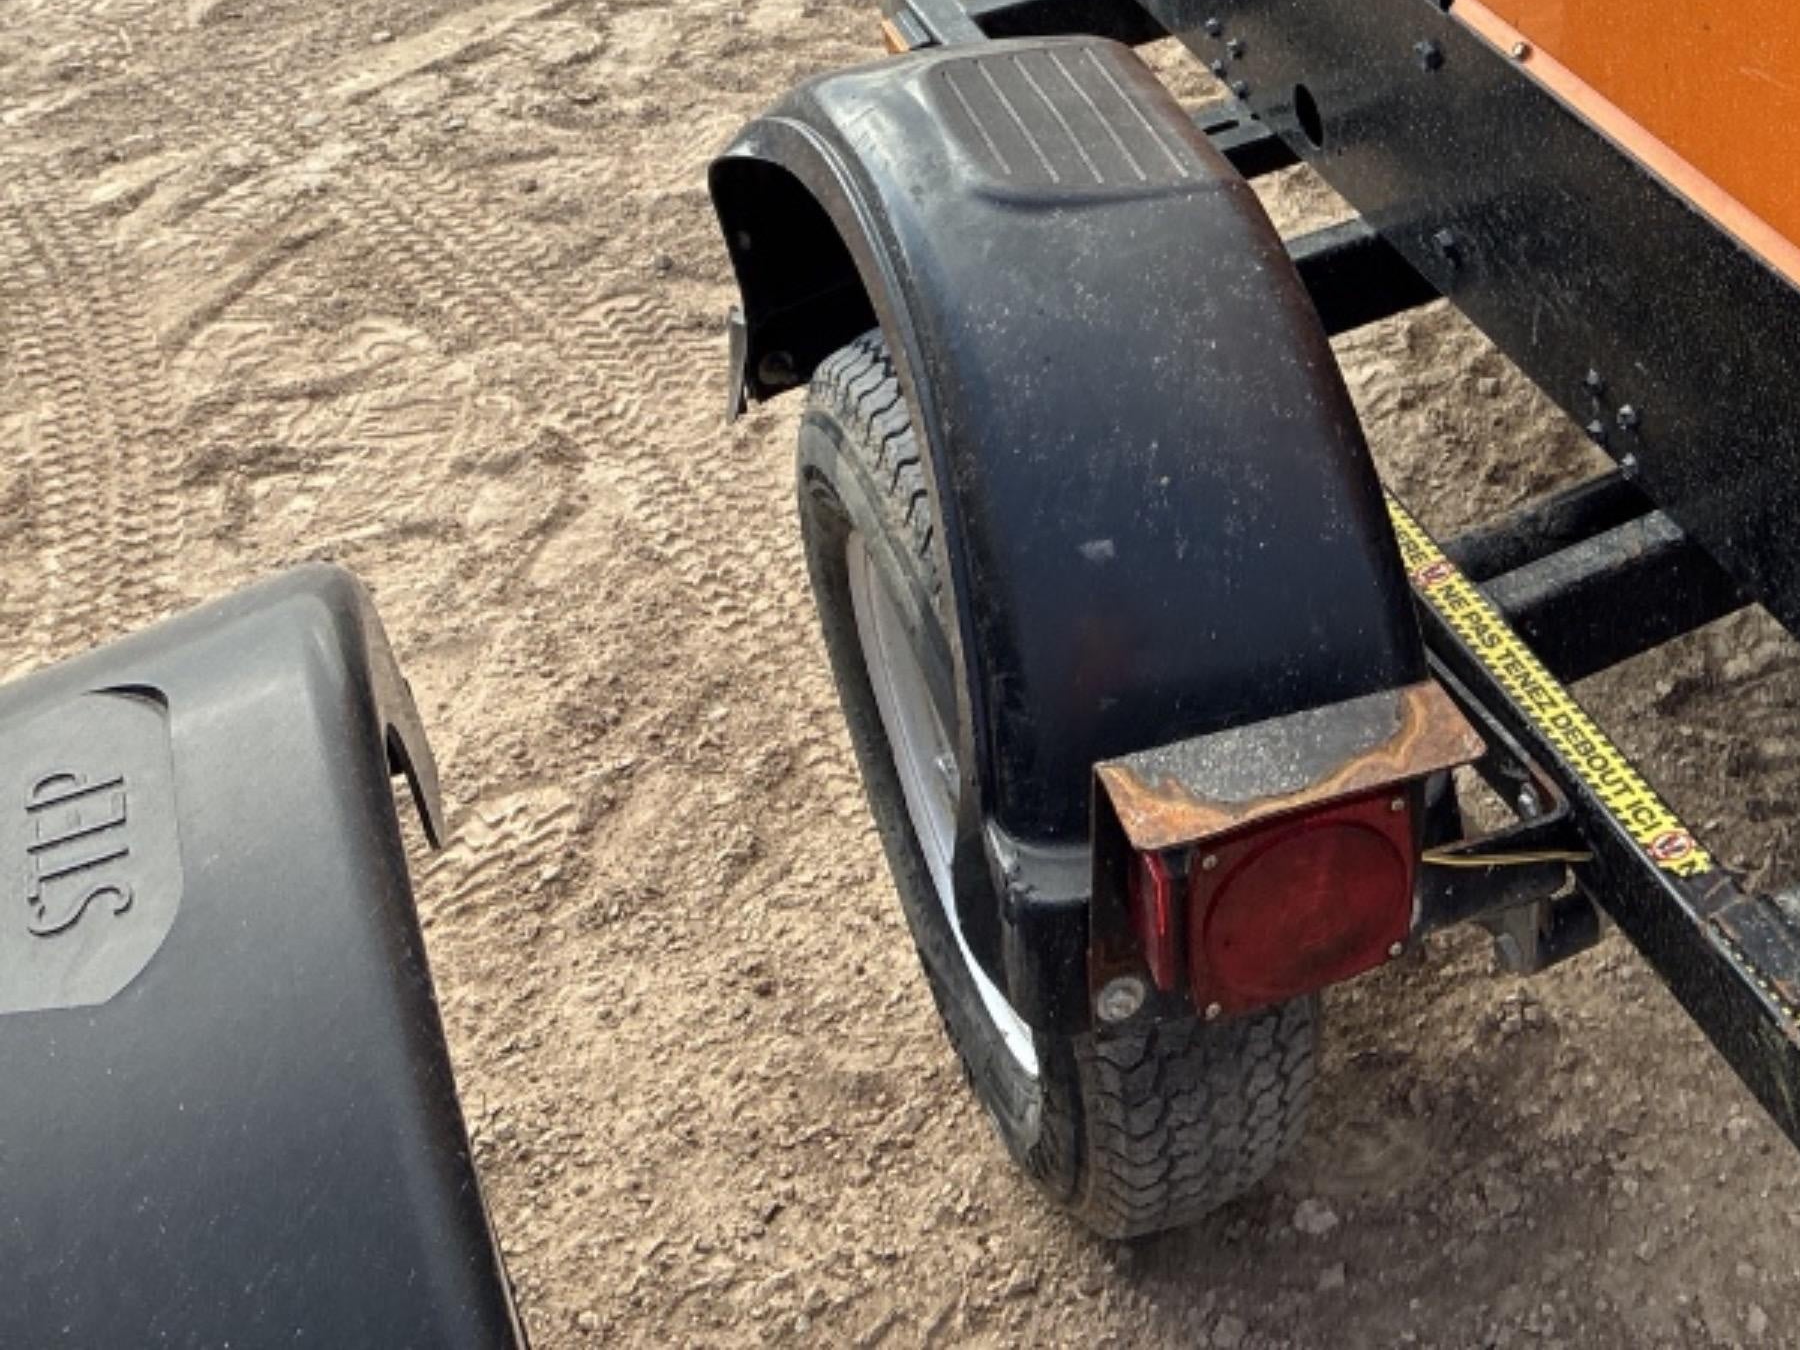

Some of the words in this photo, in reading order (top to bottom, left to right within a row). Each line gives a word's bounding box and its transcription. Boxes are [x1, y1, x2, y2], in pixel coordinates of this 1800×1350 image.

[1436, 582, 1472, 614] NE
[1462, 610, 1503, 650] PAS
[1495, 644, 1559, 713] TENEZ
[1548, 708, 1636, 799] DEBOUT
[1629, 796, 1665, 834] ICI
[26, 771, 134, 939] STEP
